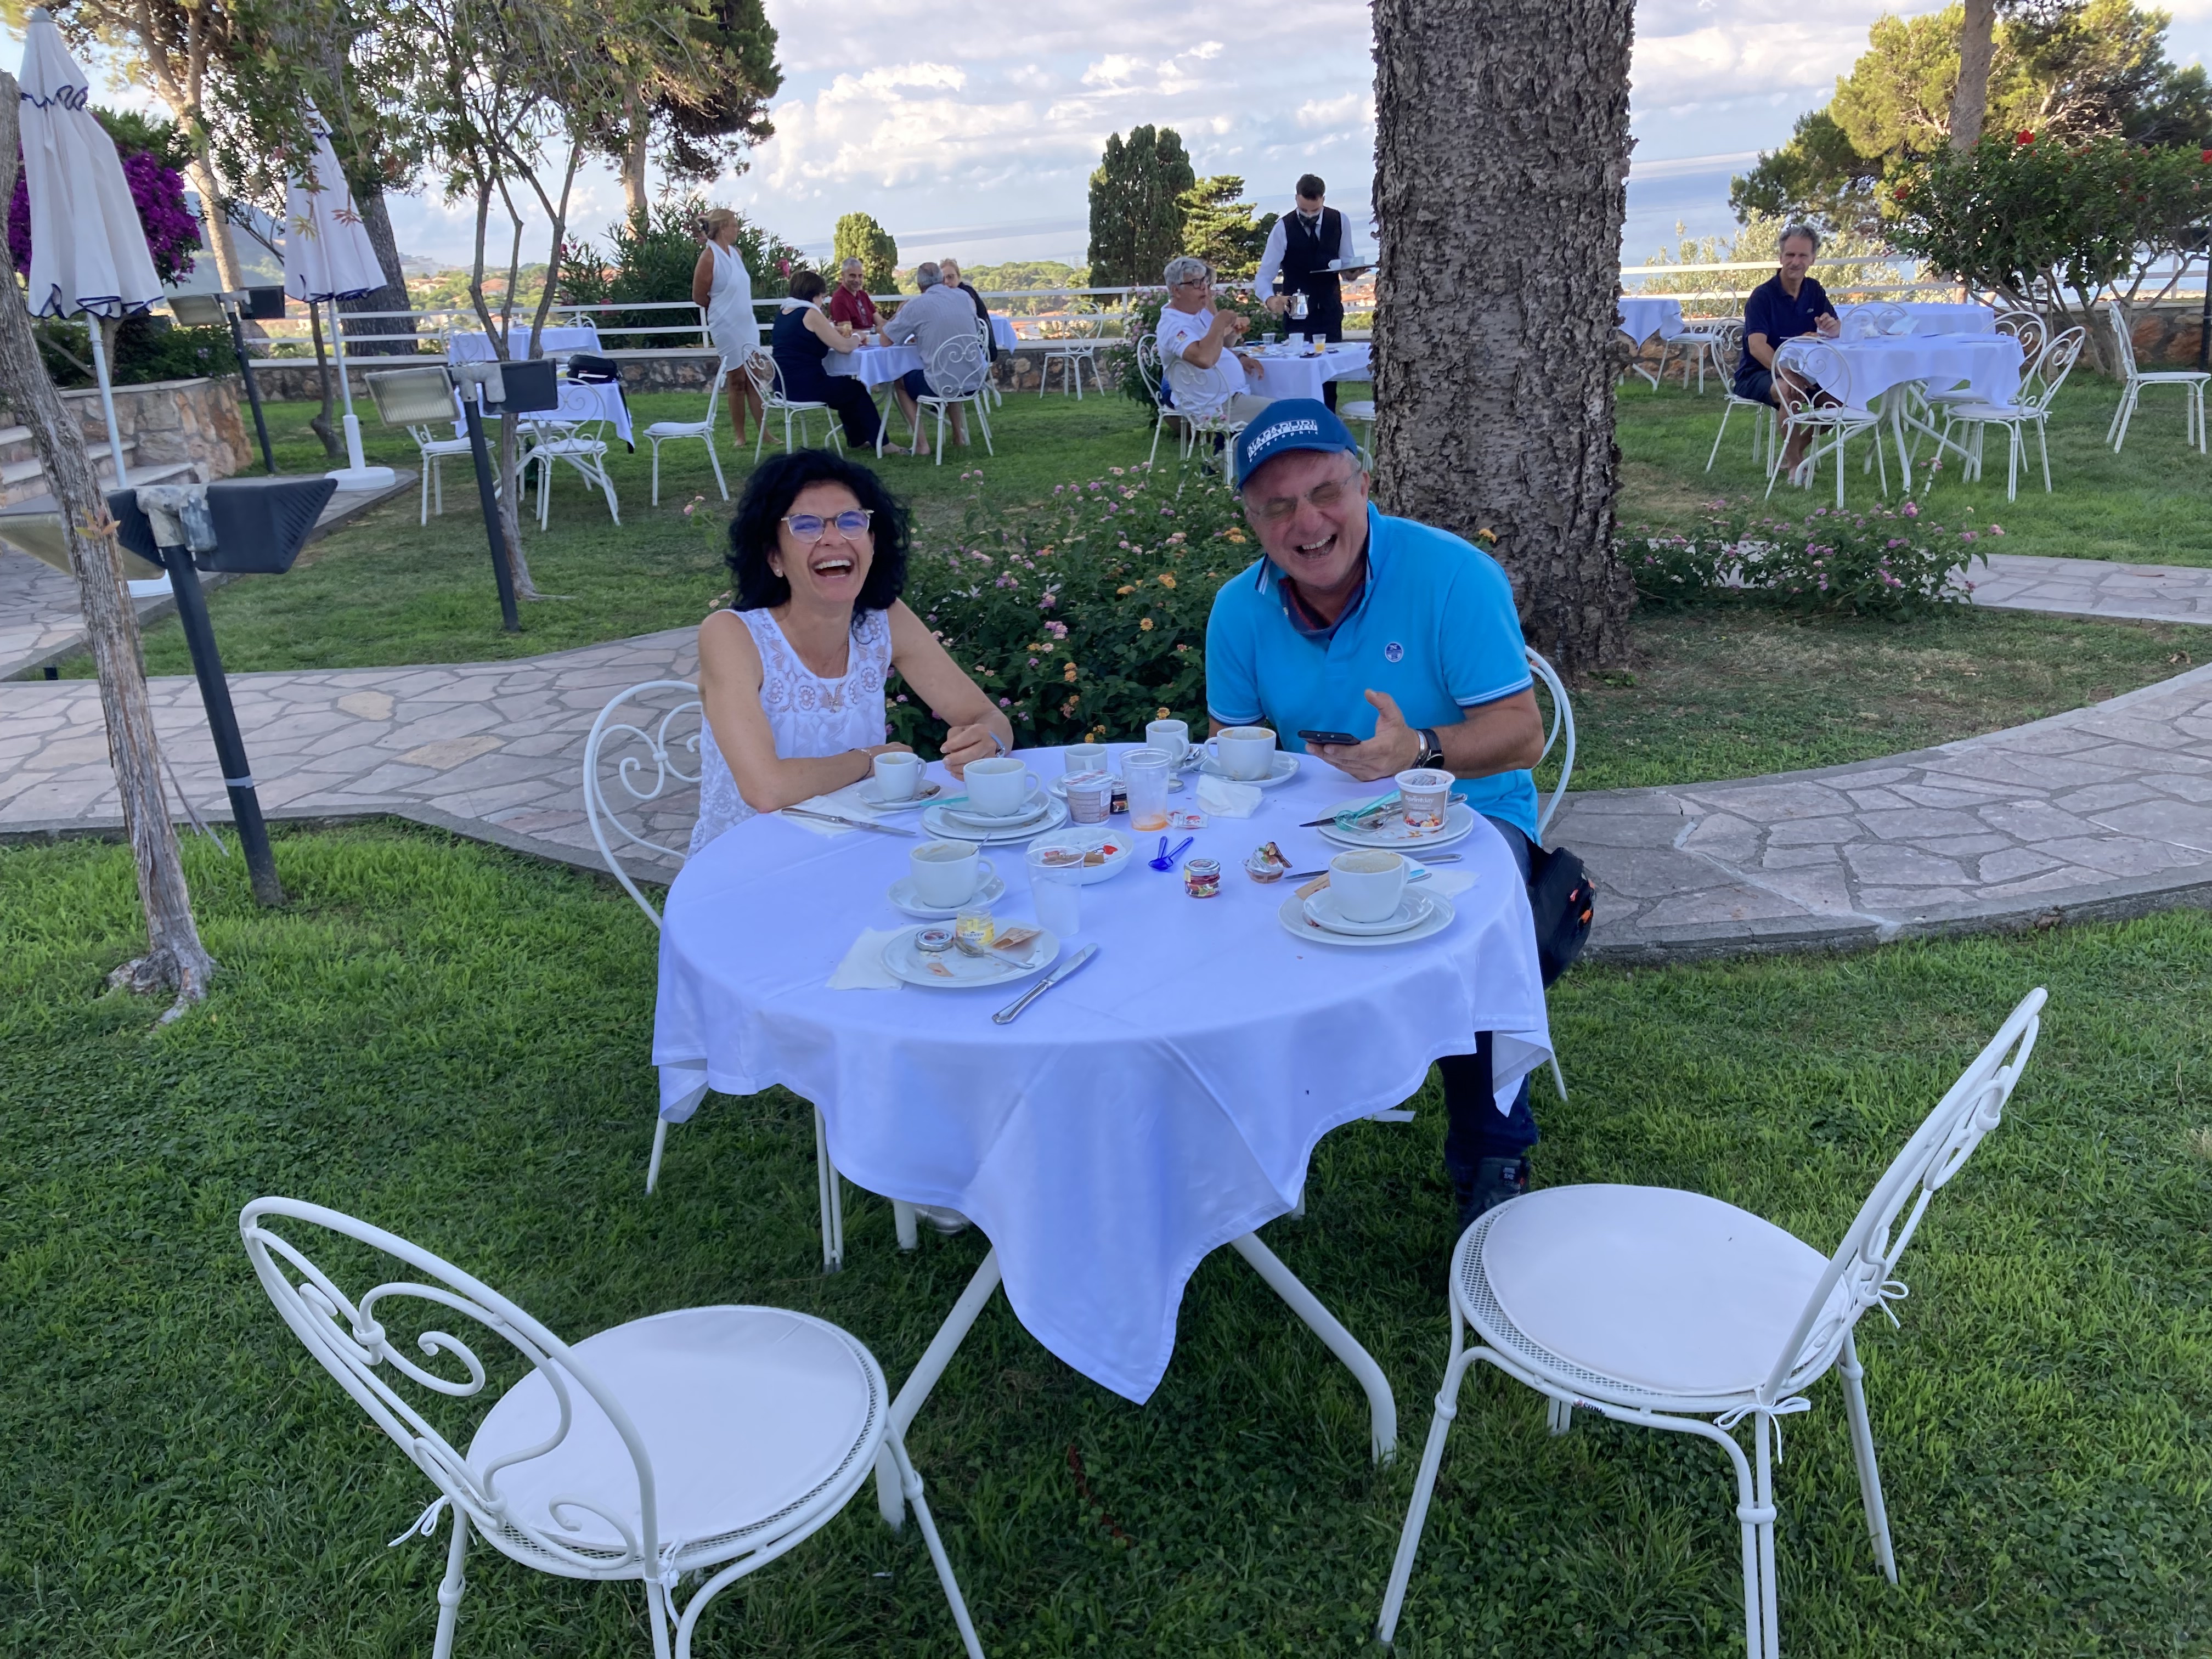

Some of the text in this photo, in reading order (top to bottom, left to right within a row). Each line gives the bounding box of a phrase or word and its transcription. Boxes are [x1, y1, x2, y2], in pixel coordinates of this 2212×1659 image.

[1247, 420, 1317, 458] NAPAPIJRI
[1405, 795, 1434, 803] Sprintday
[1583, 1402, 1602, 1413] emu
